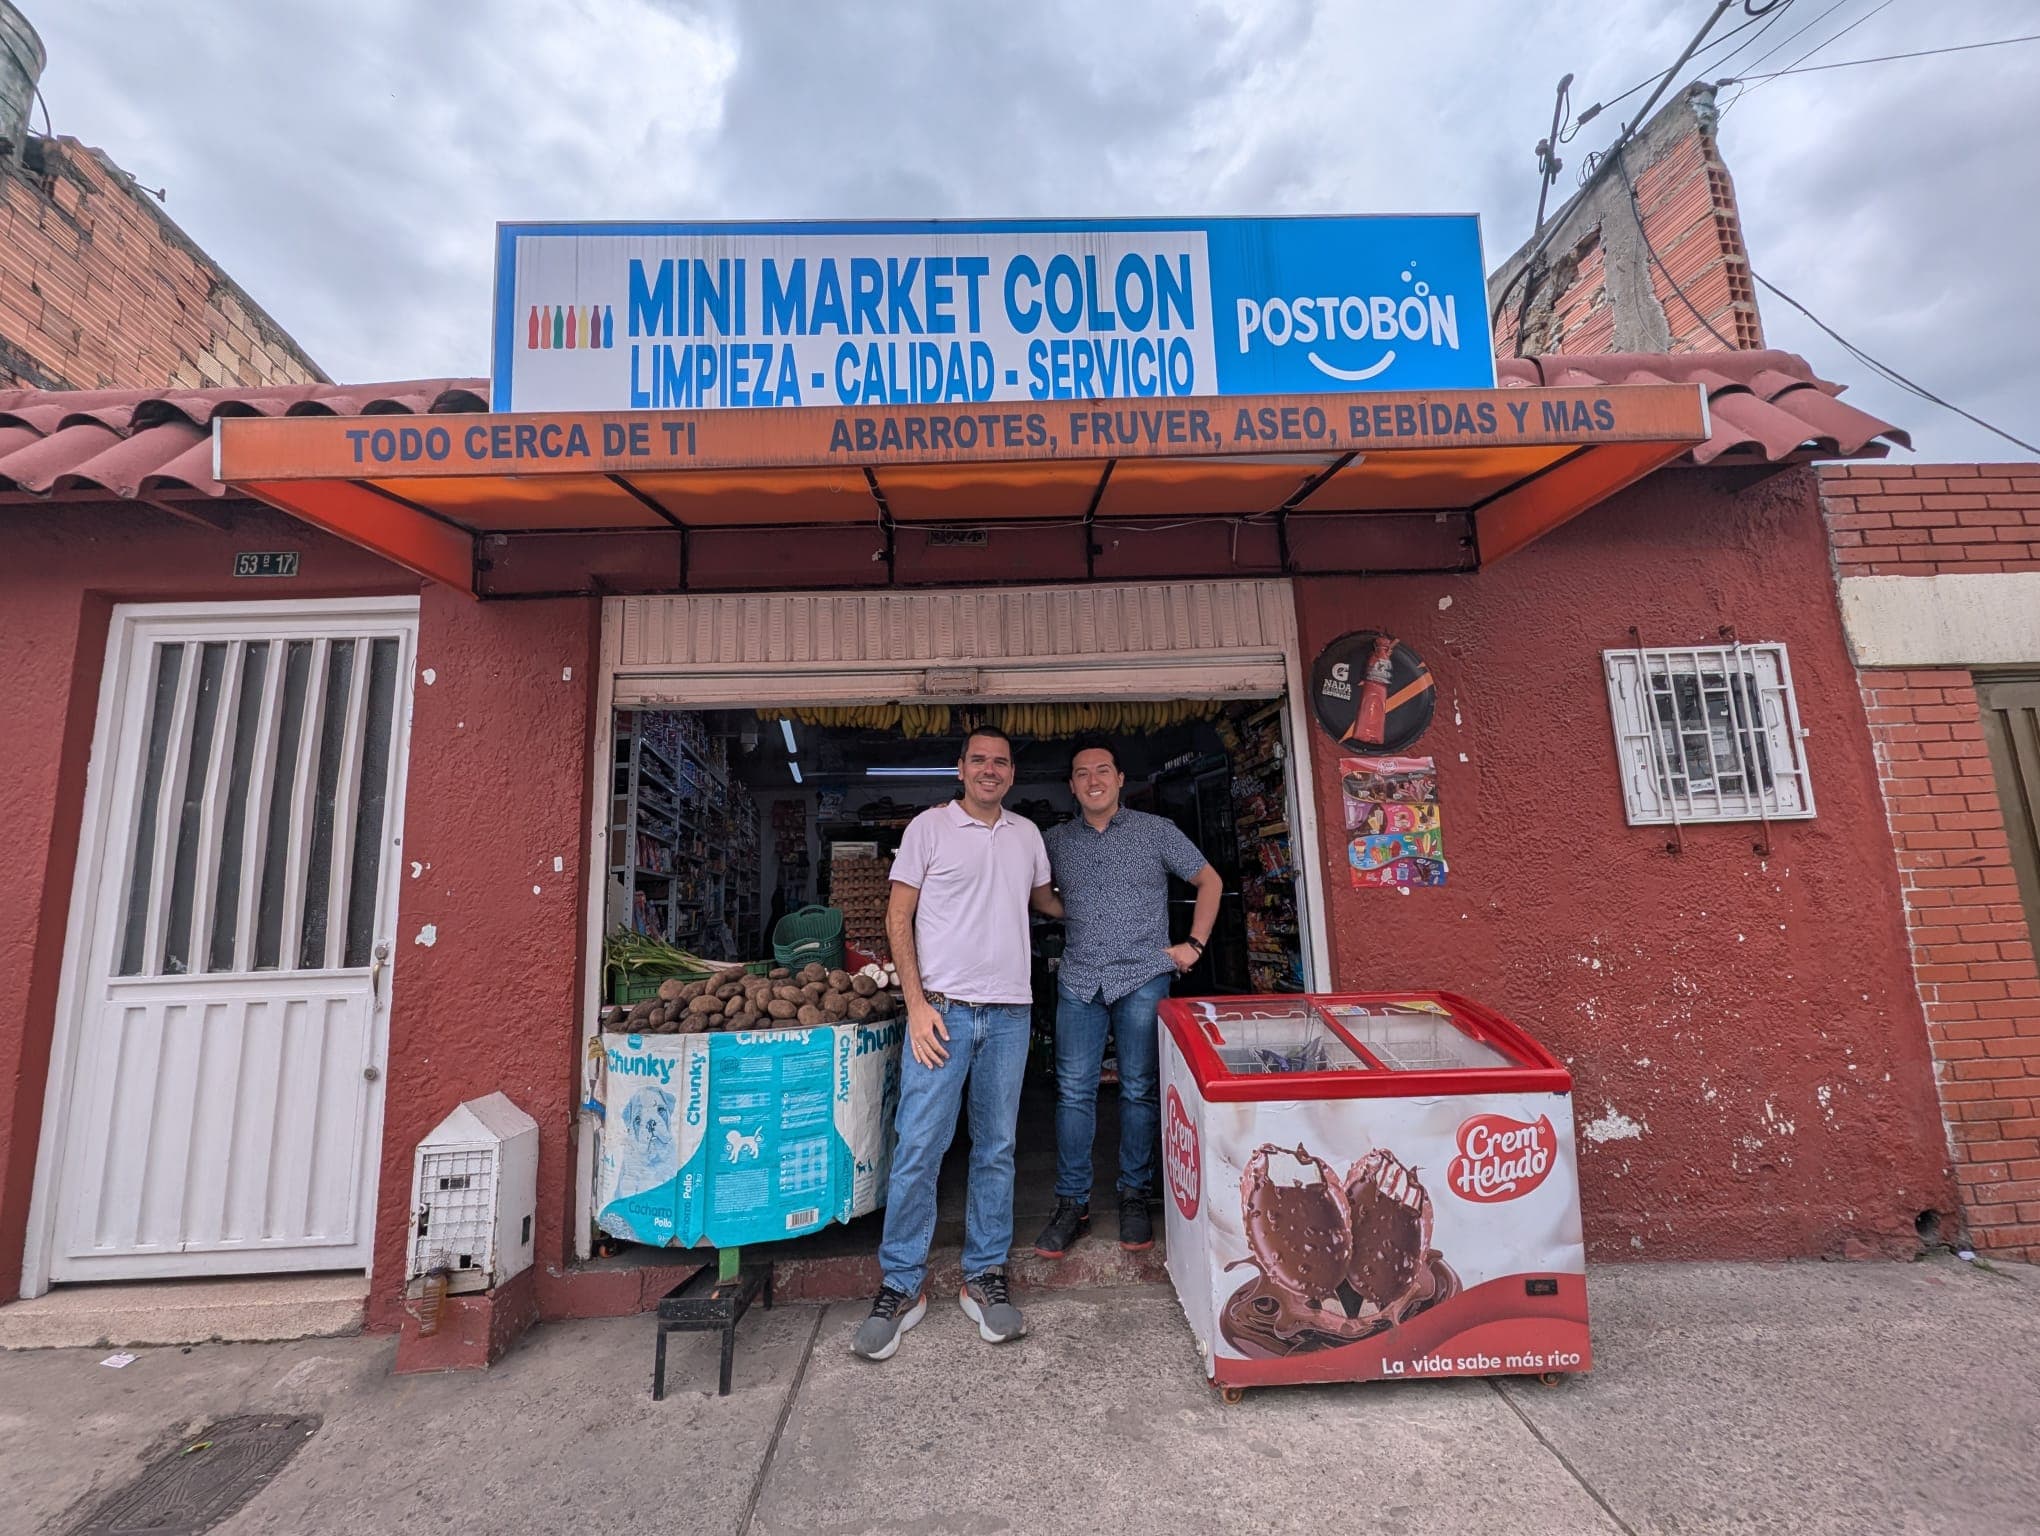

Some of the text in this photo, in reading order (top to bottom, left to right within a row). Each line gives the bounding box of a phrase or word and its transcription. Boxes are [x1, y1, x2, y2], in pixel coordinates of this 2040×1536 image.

[628, 252, 1195, 337] MINI MARKET COLON
[630, 342, 802, 409] LIMPIEZA
[835, 340, 995, 406] CALIDAD
[1028, 336, 1194, 401] SERVICIO
[346, 426, 452, 463] TODO
[463, 423, 591, 459] CERCA
[603, 422, 651, 456] DE
[662, 421, 696, 455] TI
[829, 413, 1058, 453] ABARROTES,
[1070, 409, 1222, 450] FRUVER,
[1233, 405, 1338, 446] ASEO,
[1507, 401, 1530, 433] Y
[1542, 399, 1615, 432] MAS
[239, 554, 258, 574] 53
[275, 554, 294, 573] 17
[1323, 678, 1351, 693] NADA
[607, 1048, 676, 1085] Chunky
[837, 1034, 851, 1103] Chunky
[686, 1052, 707, 1126] Chunky
[1169, 1098, 1195, 1162] Crem
[1465, 1125, 1541, 1160] Crem
[682, 1173, 693, 1199] Pollo
[1167, 1134, 1198, 1206] Helado
[1457, 1147, 1549, 1197] Helado
[628, 1200, 673, 1218] Cachorro
[654, 1217, 673, 1229] Pollo
[1382, 1350, 1580, 1375] La vida sabe más rico
